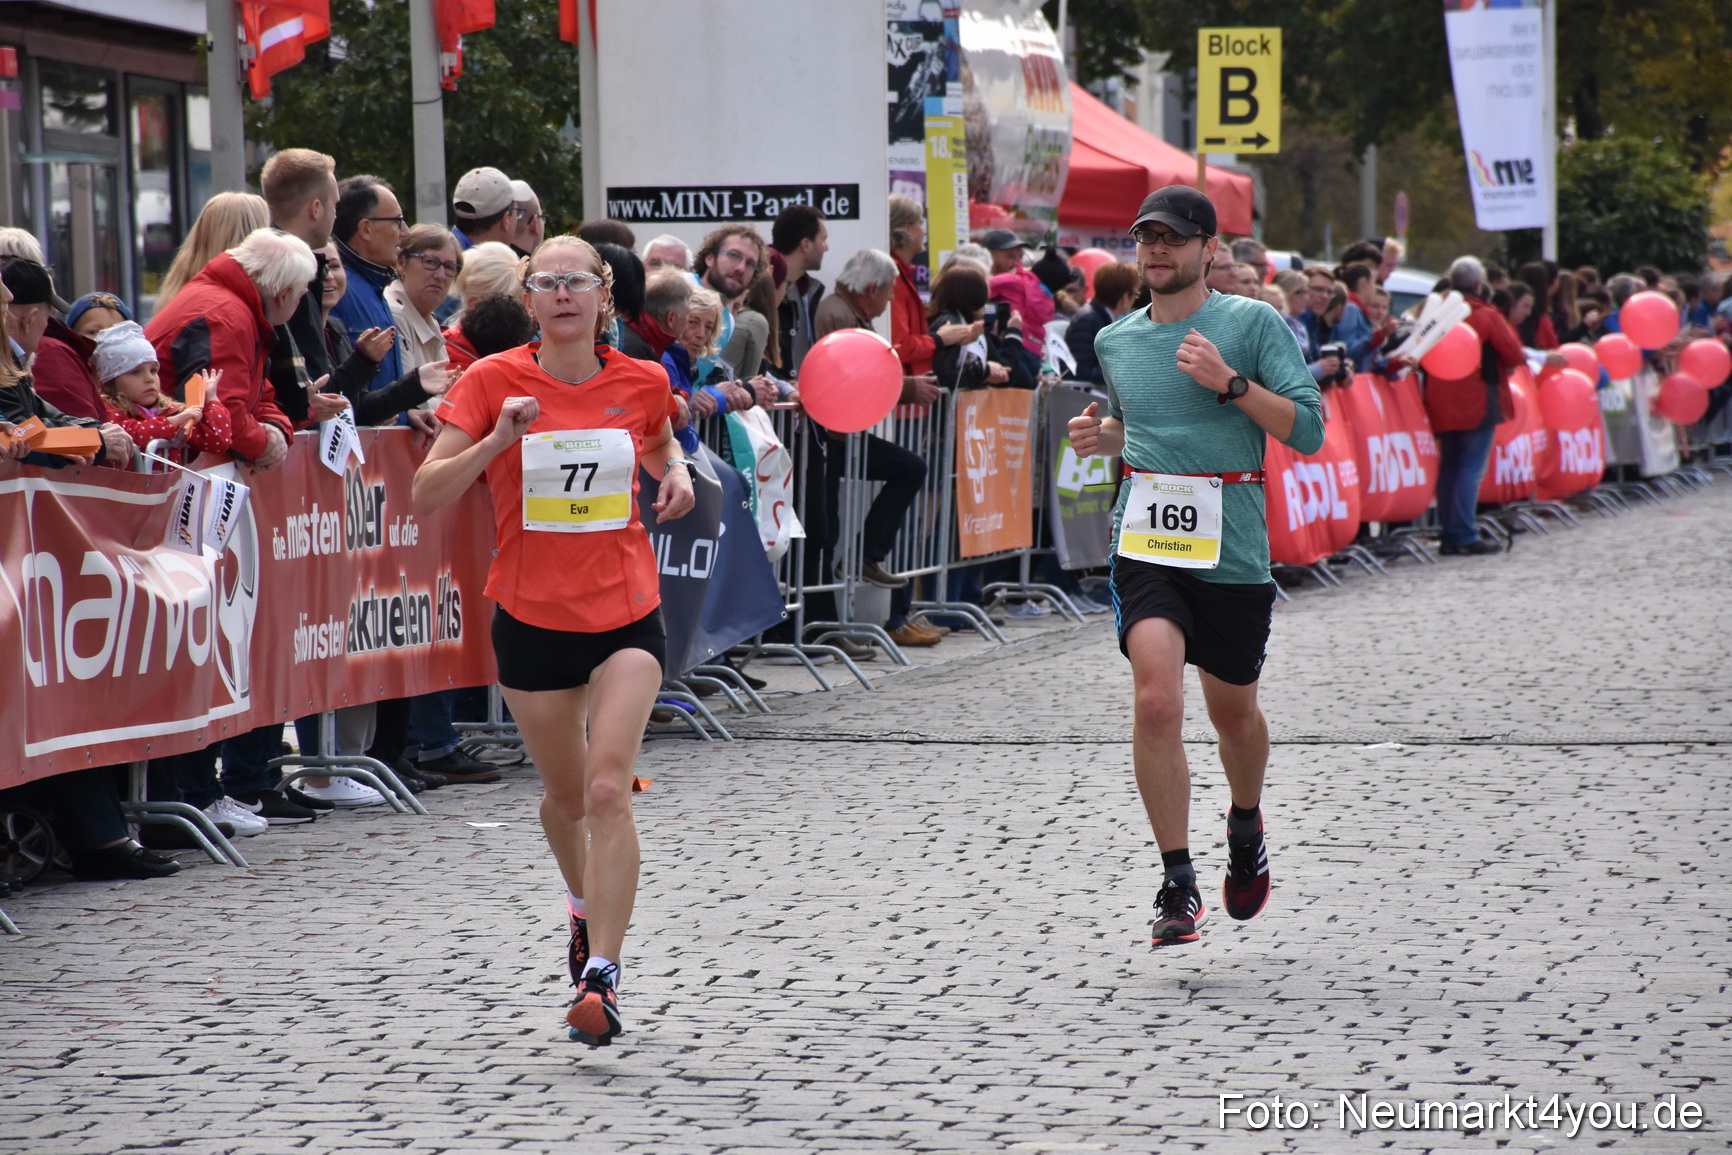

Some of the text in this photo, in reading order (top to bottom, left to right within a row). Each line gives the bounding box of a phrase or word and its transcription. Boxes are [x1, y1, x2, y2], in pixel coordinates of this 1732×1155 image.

[1208, 34, 1271, 56] Block
[1219, 67, 1259, 125] B
[929, 136, 953, 159] 18.
[328, 425, 342, 464] swn
[565, 439, 601, 449] BOCK
[560, 462, 599, 493] 77
[1160, 483, 1194, 493] BOCK
[180, 482, 195, 527] swn
[220, 480, 236, 523] swn
[273, 527, 286, 560] die
[345, 467, 386, 552] 80er
[570, 503, 589, 515] Eva
[402, 515, 418, 546] die
[1146, 502, 1198, 532] 169
[1147, 538, 1192, 552] Christian
